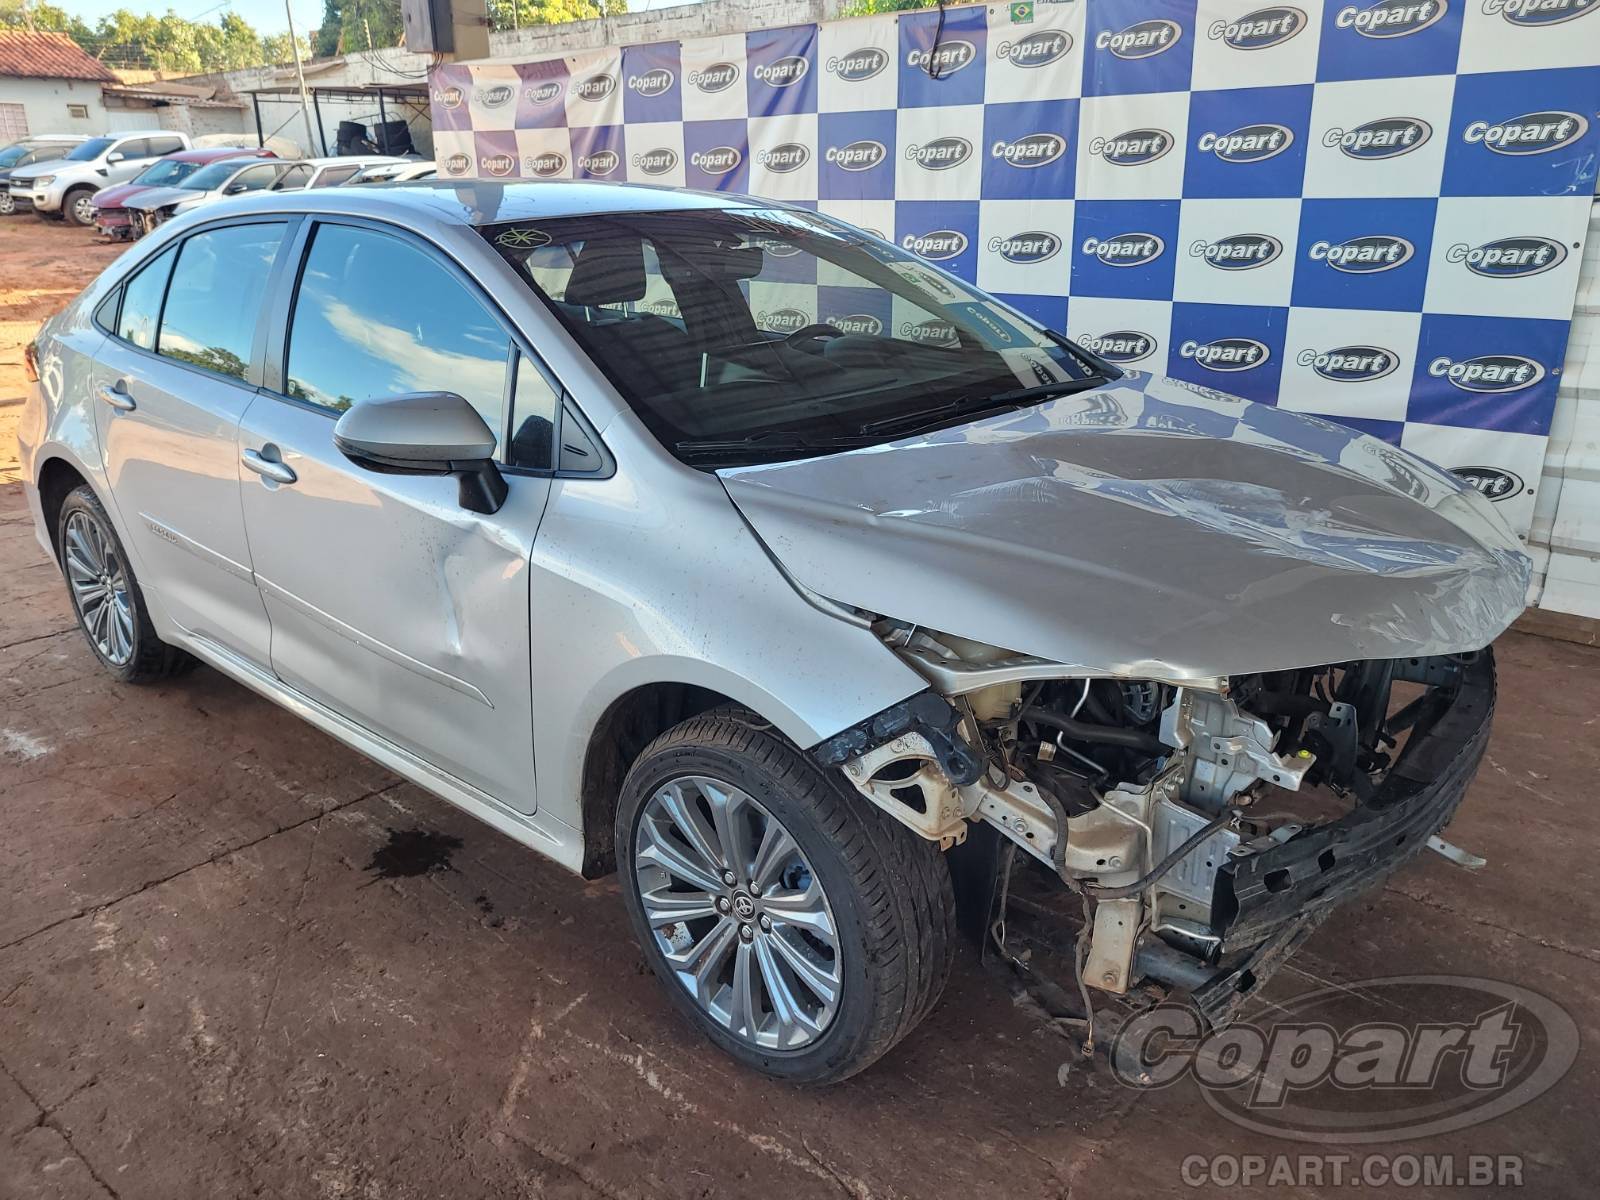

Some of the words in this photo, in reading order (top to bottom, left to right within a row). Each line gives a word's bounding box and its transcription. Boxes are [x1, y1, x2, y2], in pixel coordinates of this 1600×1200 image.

[1207, 11, 1295, 44] Copart
[1335, 1, 1435, 32] Copart
[996, 35, 1062, 60] Copart
[1096, 24, 1172, 52] Copart
[826, 53, 880, 75] Copart
[907, 45, 967, 70] Copart
[688, 69, 732, 87] Copart
[754, 61, 802, 82] Copart
[525, 86, 558, 100] Copart
[571, 79, 610, 97] Copart
[628, 75, 667, 92] Copart
[434, 90, 461, 106] Copart
[1198, 129, 1283, 157] Copart
[1322, 123, 1418, 152] Copart
[1463, 117, 1574, 149] Copart
[826, 145, 879, 164] Copart
[905, 141, 964, 163] Copart
[992, 138, 1056, 160] Copart
[1089, 133, 1163, 159] Copart
[481, 157, 511, 172] Copart
[525, 156, 560, 172] Copart
[577, 155, 614, 172] Copart
[632, 153, 672, 171] Copart
[691, 151, 734, 169] Copart
[757, 149, 803, 167] Copart
[902, 233, 962, 255] Copart
[988, 236, 1052, 256] Copart
[1082, 237, 1155, 258] Copart
[1188, 239, 1273, 262] Copart
[1309, 240, 1404, 264] Copart
[1445, 243, 1553, 269] Copart
[757, 311, 806, 331] Copart
[900, 321, 957, 341] Copart
[1076, 333, 1147, 355] Copart
[1179, 339, 1261, 366] Copart
[1296, 348, 1388, 375] Copart
[1427, 357, 1534, 384] Copart
